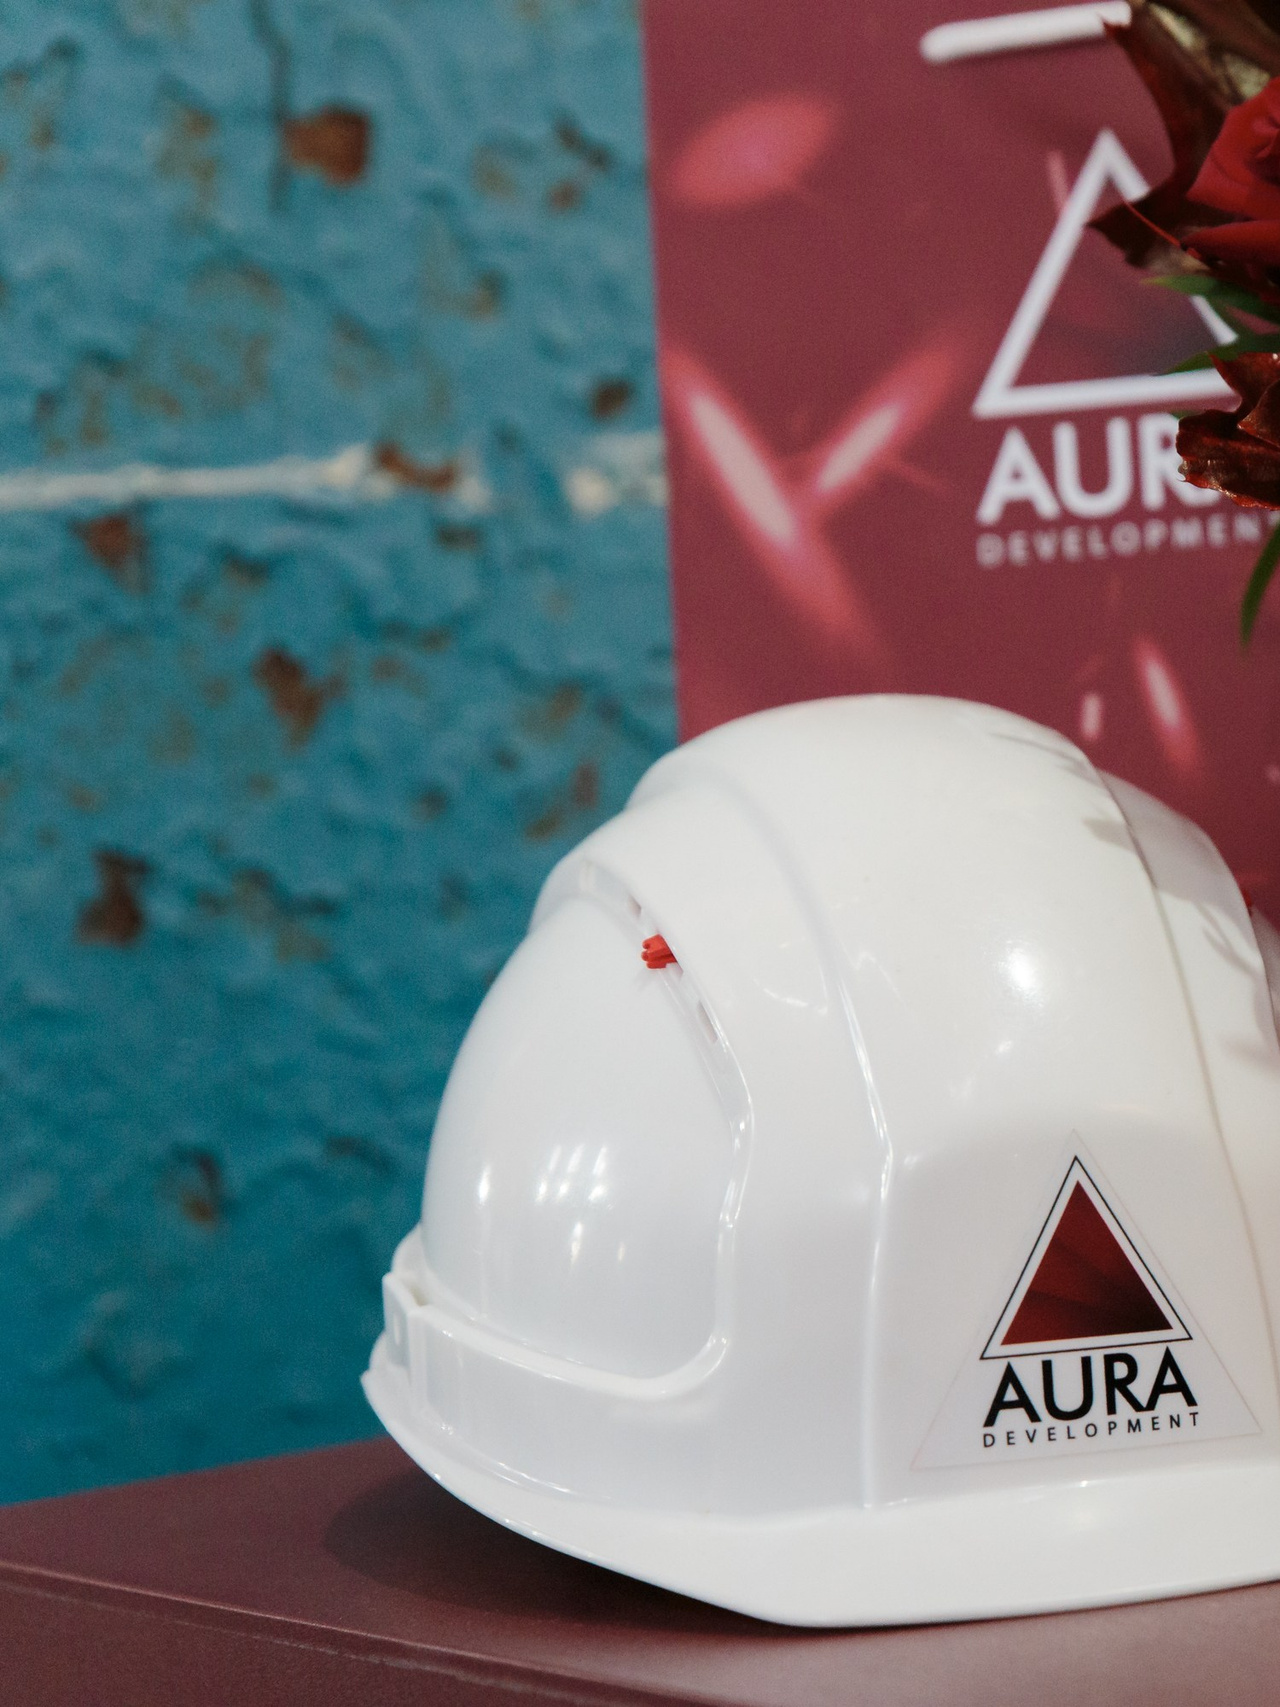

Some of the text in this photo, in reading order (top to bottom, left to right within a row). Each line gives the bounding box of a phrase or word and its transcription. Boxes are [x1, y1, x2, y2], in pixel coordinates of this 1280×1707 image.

[977, 412, 1221, 526] AUR
[983, 1346, 1198, 1428] AURA
[983, 1412, 1200, 1449] DEVELOPMENT
